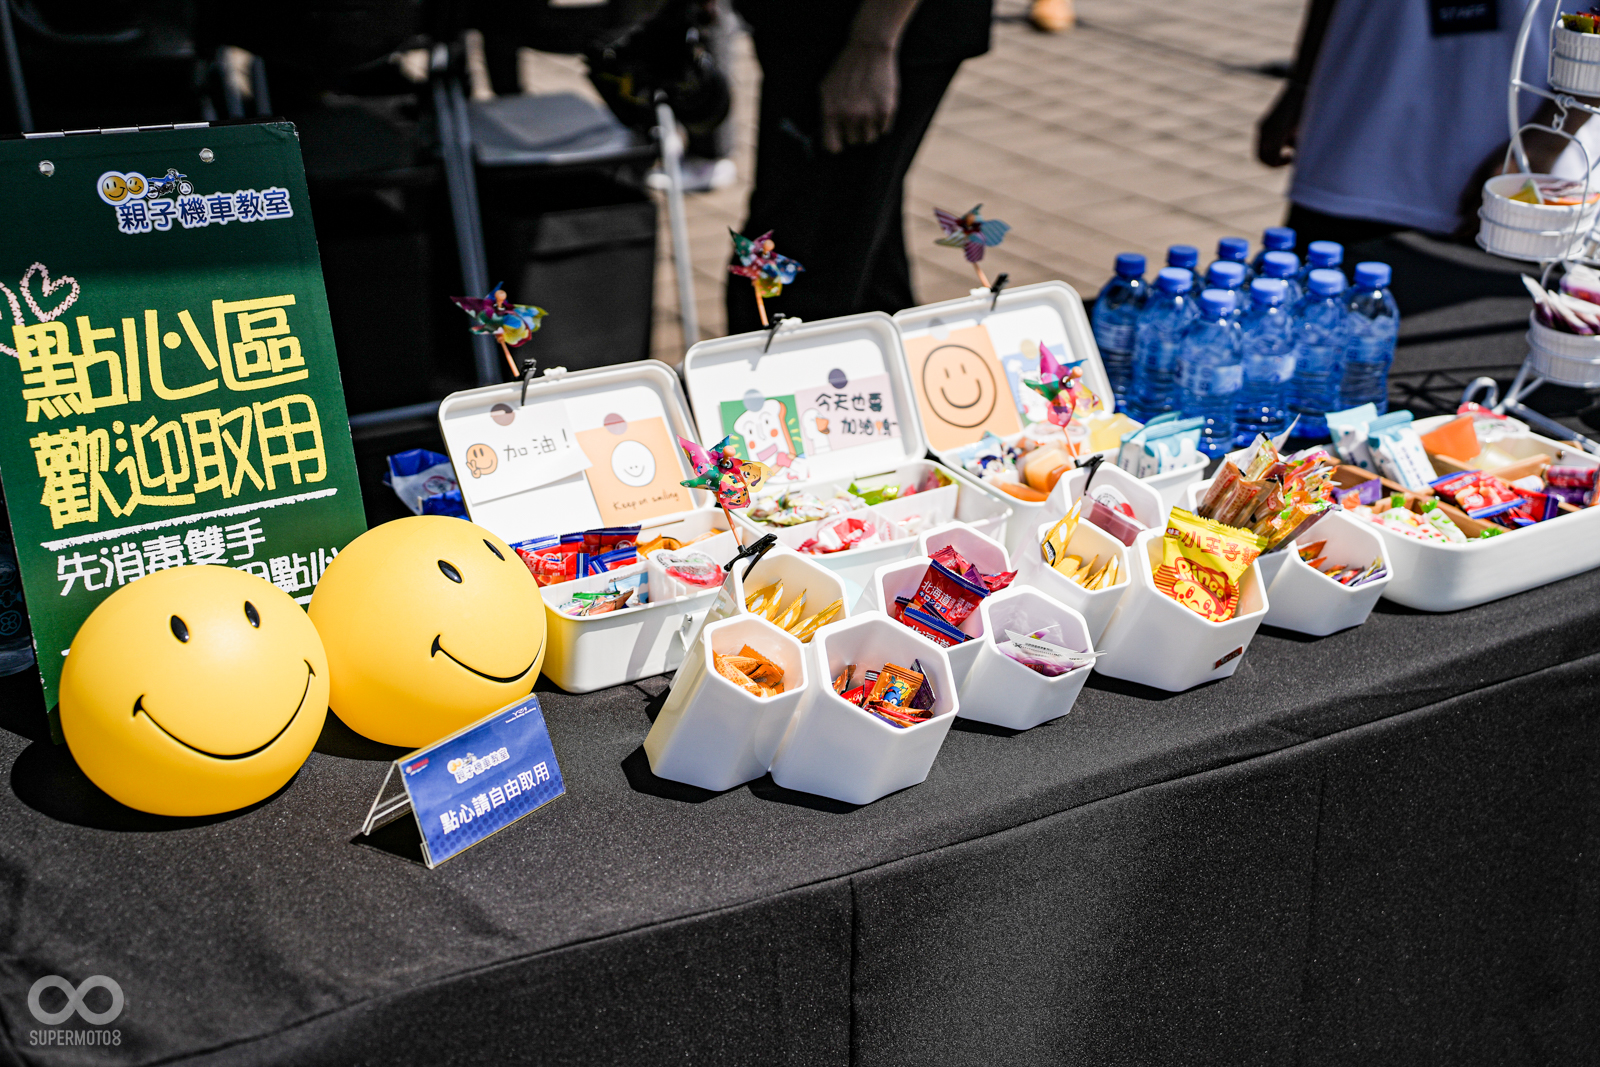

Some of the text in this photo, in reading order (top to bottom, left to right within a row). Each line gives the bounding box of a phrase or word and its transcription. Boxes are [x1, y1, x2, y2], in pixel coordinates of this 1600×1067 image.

[118, 189, 292, 233] 親子機車教室
[12, 294, 309, 423] 點心區
[29, 394, 328, 530] 歡迎取用
[612, 501, 637, 511] Keep
[57, 517, 266, 596] 先消毒雙手
[1177, 560, 1224, 598] Prince
[921, 580, 952, 607] 北海道
[439, 760, 551, 835] 點心請自由取用
